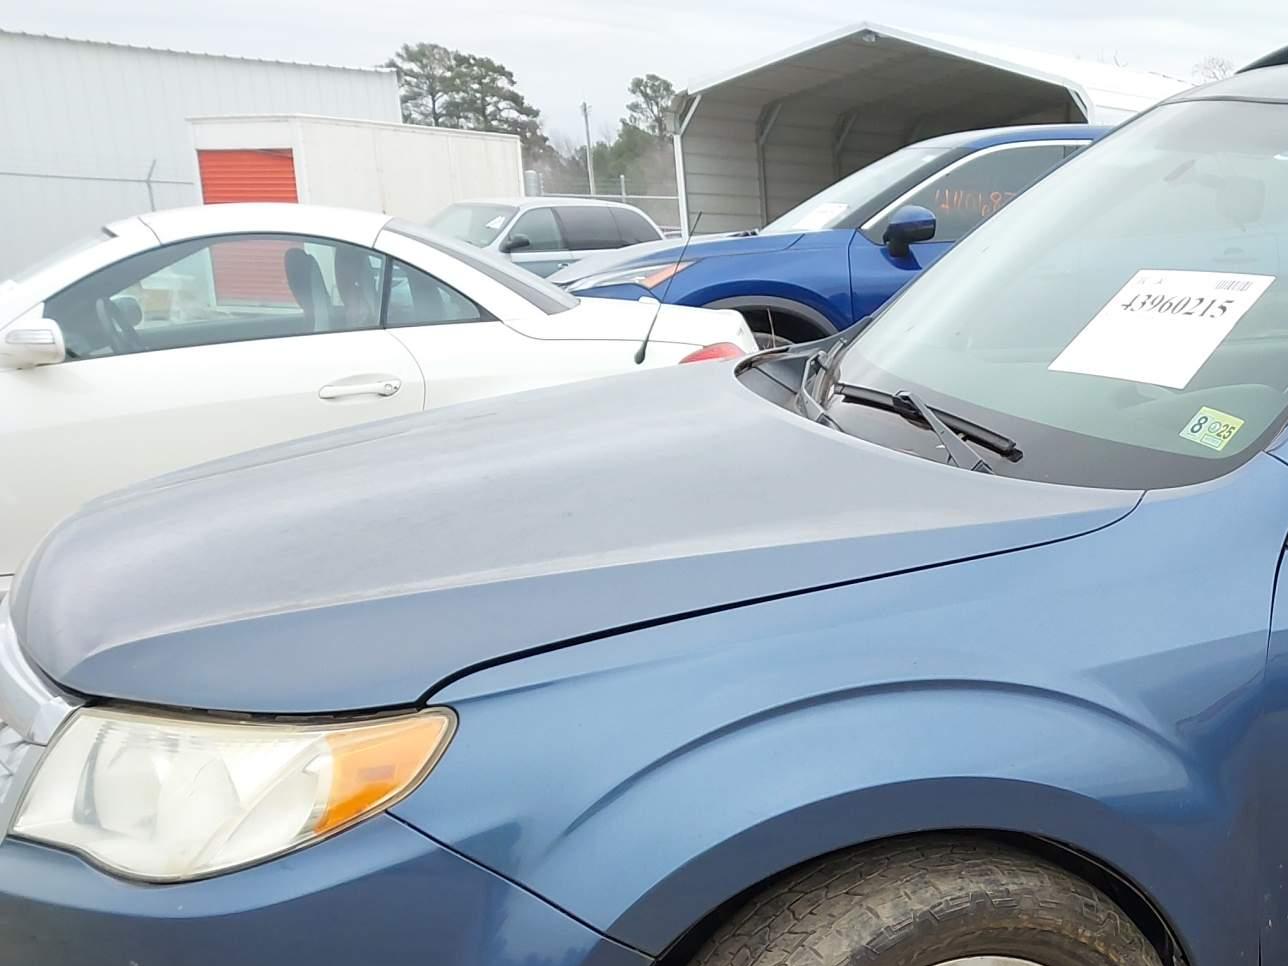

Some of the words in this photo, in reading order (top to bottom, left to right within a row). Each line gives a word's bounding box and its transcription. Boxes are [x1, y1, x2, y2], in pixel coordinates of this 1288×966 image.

[1120, 293, 1235, 319] 43960215
[1190, 415, 1209, 435] 8
[1215, 422, 1236, 440] 25
